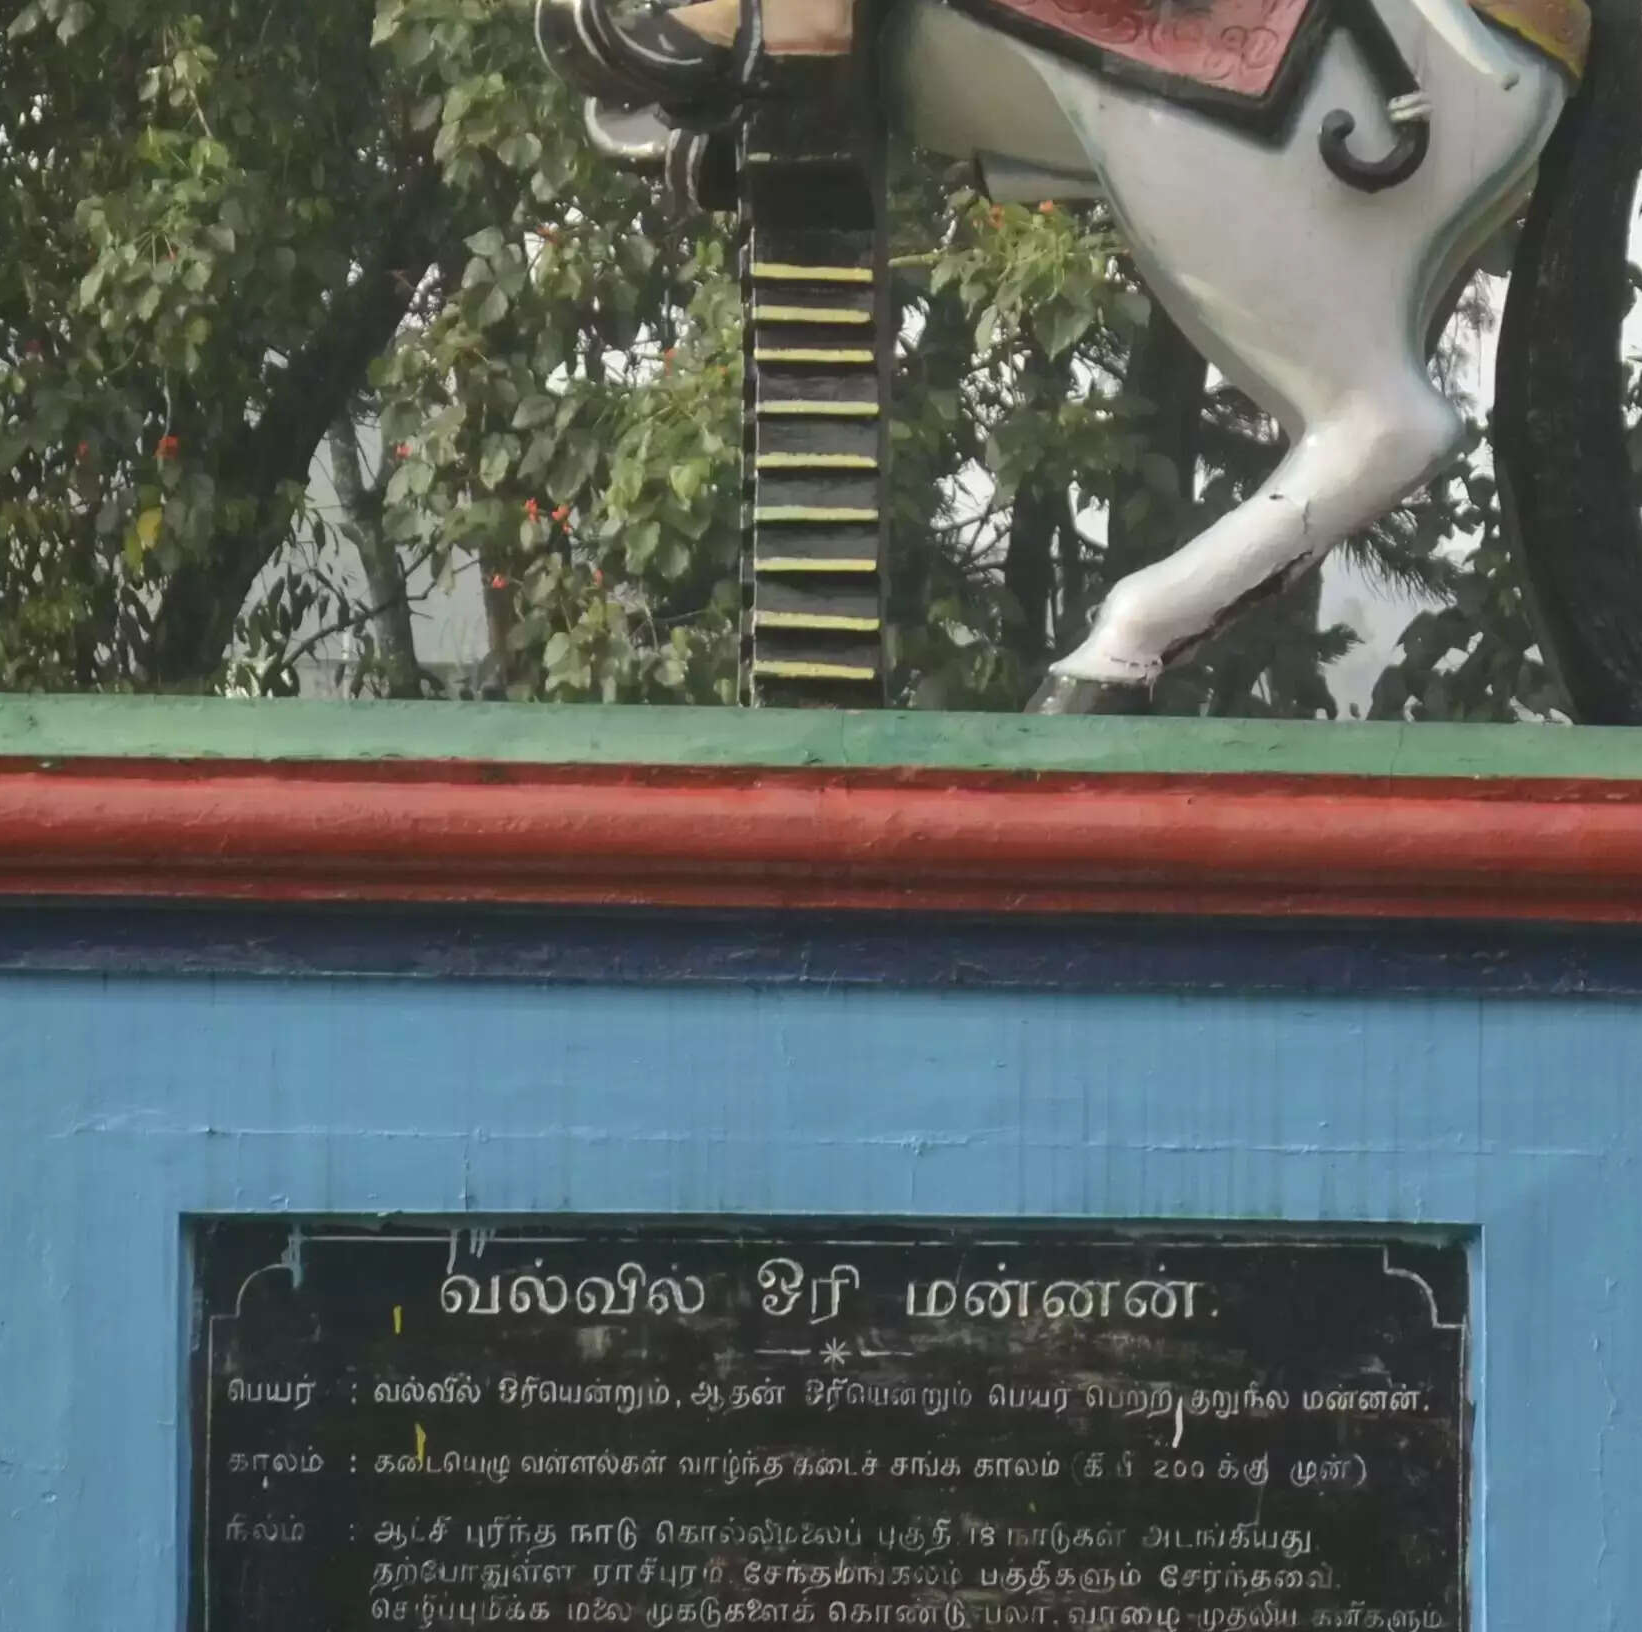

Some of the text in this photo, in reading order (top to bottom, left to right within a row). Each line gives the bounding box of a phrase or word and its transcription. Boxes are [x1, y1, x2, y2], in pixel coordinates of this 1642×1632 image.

[441, 1257, 705, 1315] வல்வில்
[227, 1374, 317, 1411] பெயர்
[373, 1375, 482, 1406] வல்வில்
[689, 1375, 786, 1416] ஆதன்
[228, 1445, 324, 1474] காலம்
[521, 1447, 668, 1476] வள்ளல்கள்
[679, 1447, 784, 1487] வாழ்ந்த
[792, 1448, 879, 1477] கடைச்
[889, 1449, 961, 1477] சங்க
[973, 1451, 1060, 1479] காலம்
[1153, 1459, 1205, 1479] 200
[466, 1516, 557, 1555] புரிந்த
[570, 1516, 638, 1550] நாடு
